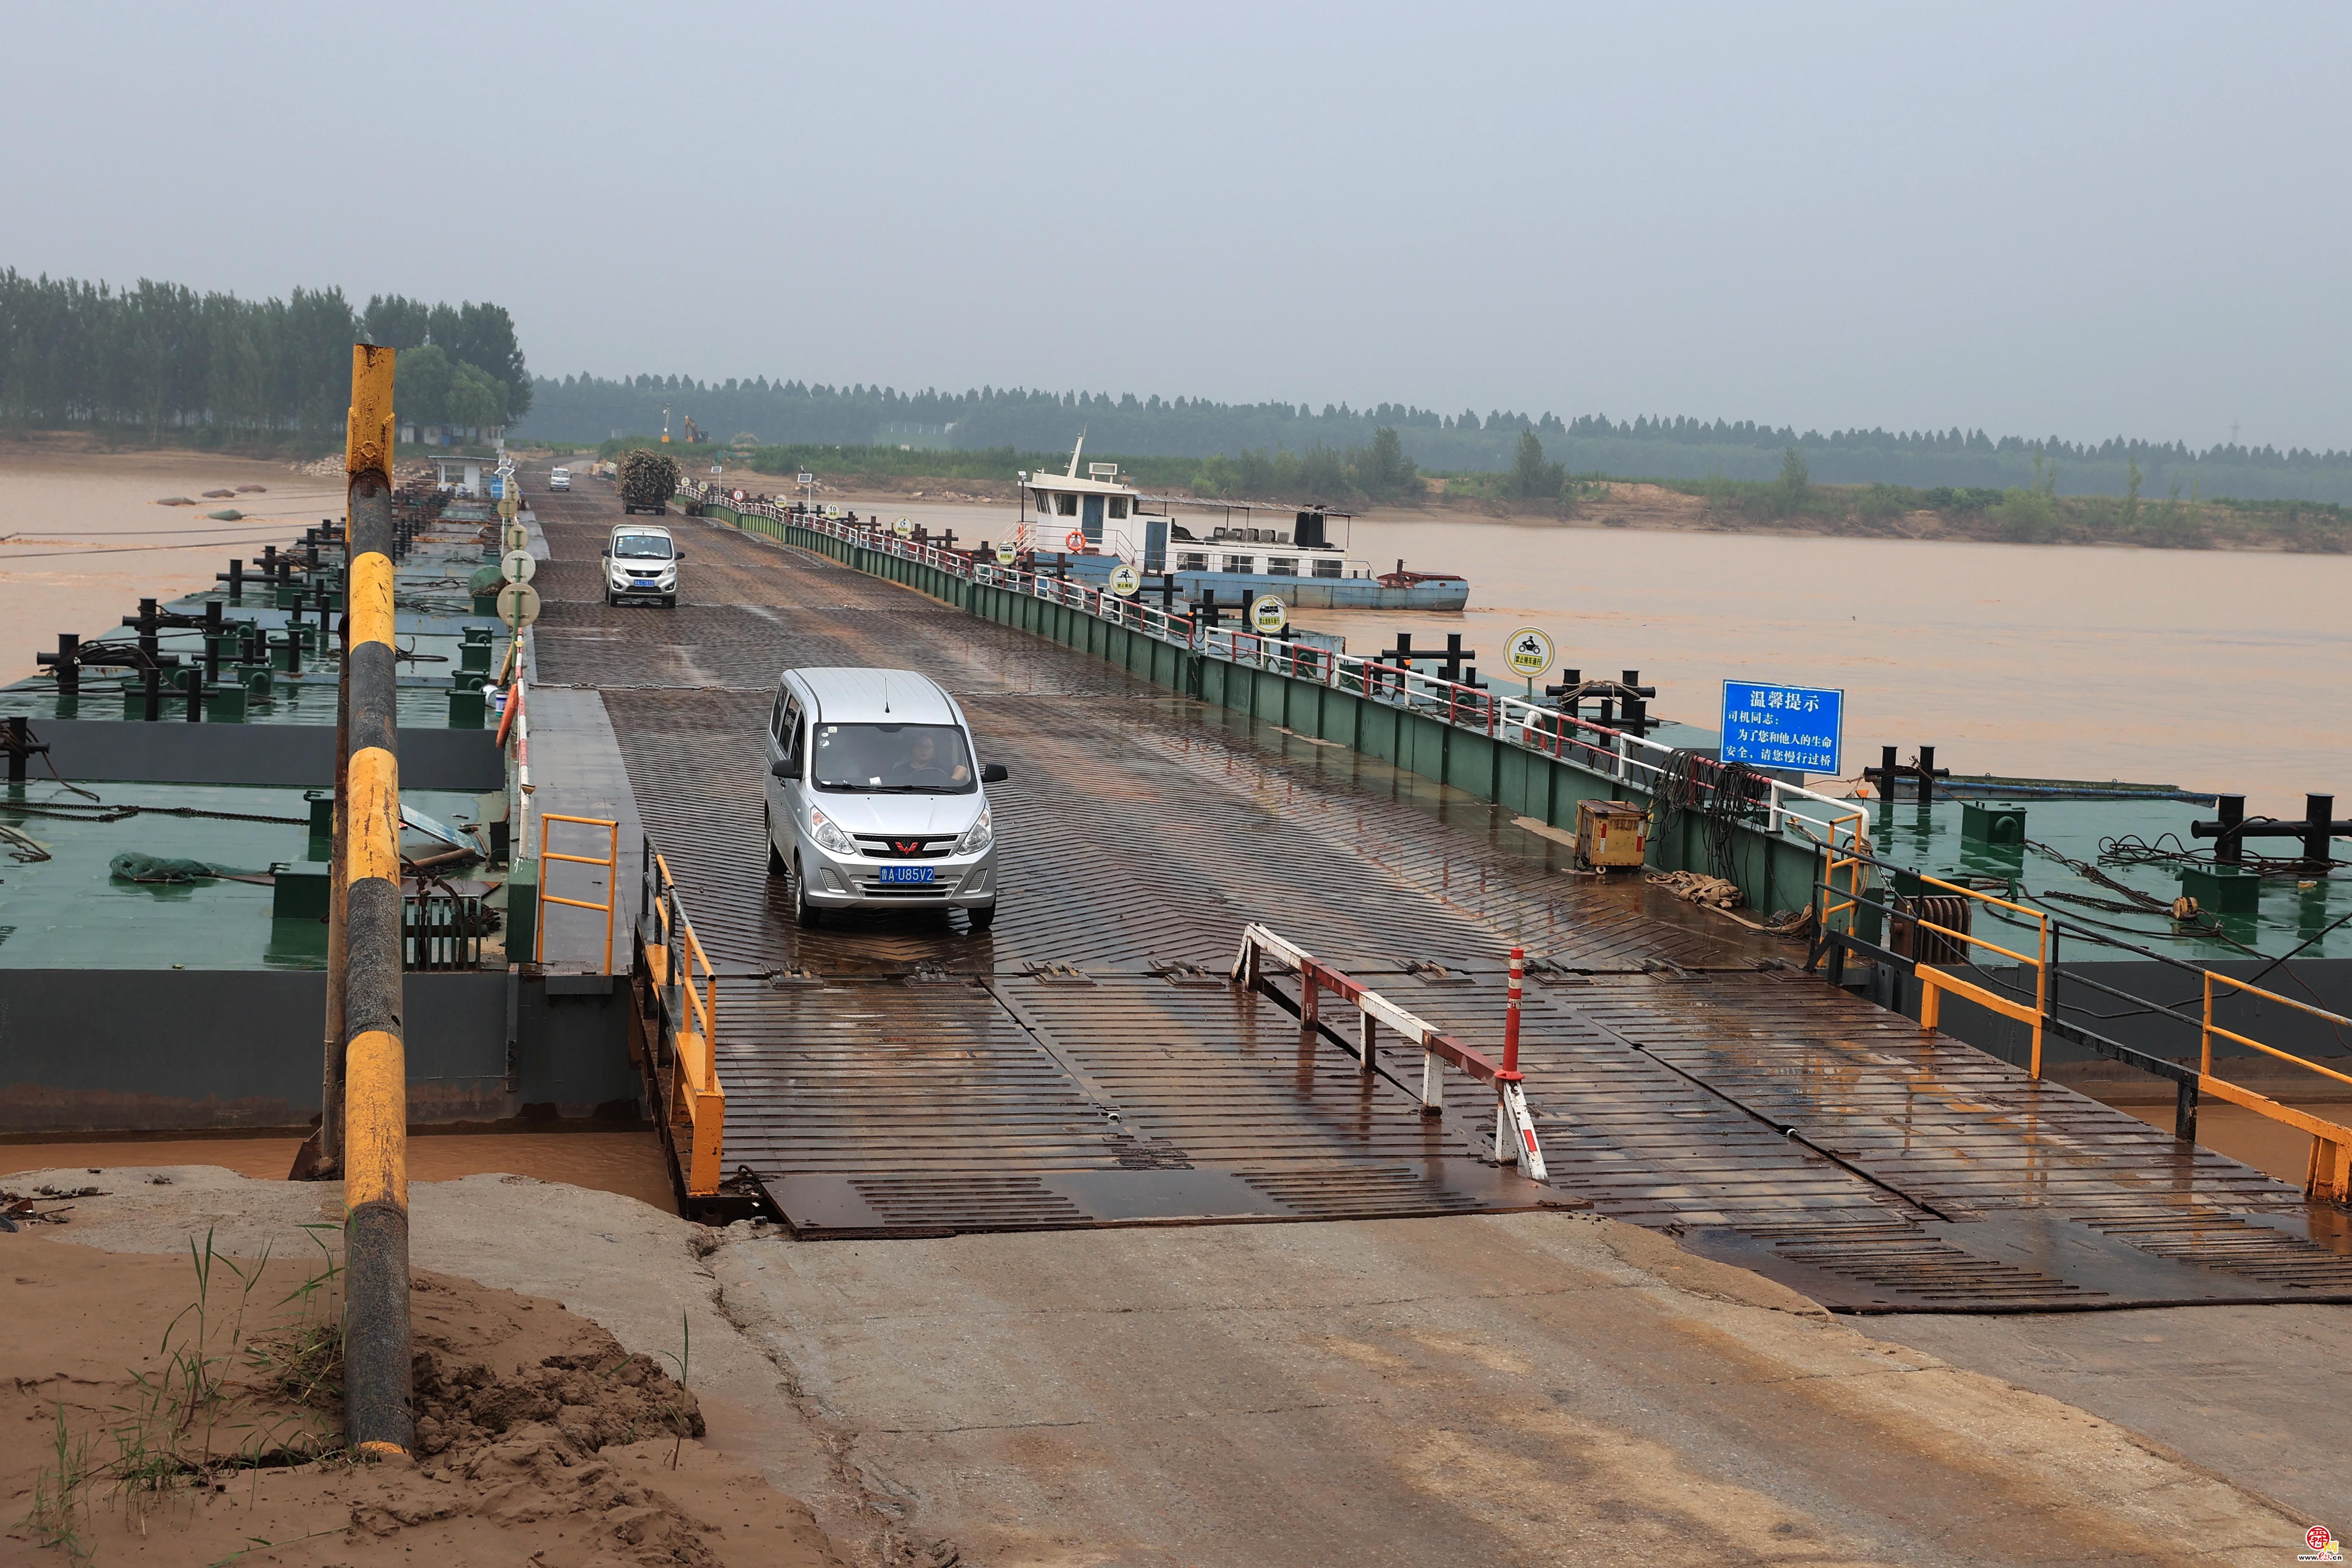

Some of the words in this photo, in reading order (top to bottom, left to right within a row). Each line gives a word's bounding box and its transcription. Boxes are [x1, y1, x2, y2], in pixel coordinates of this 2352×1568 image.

[1750, 690, 1820, 712] 温馨提示
[1737, 728, 1833, 749] 为了您和他人的生命
[1725, 745, 1831, 767] 安全，请您慢行过桥
